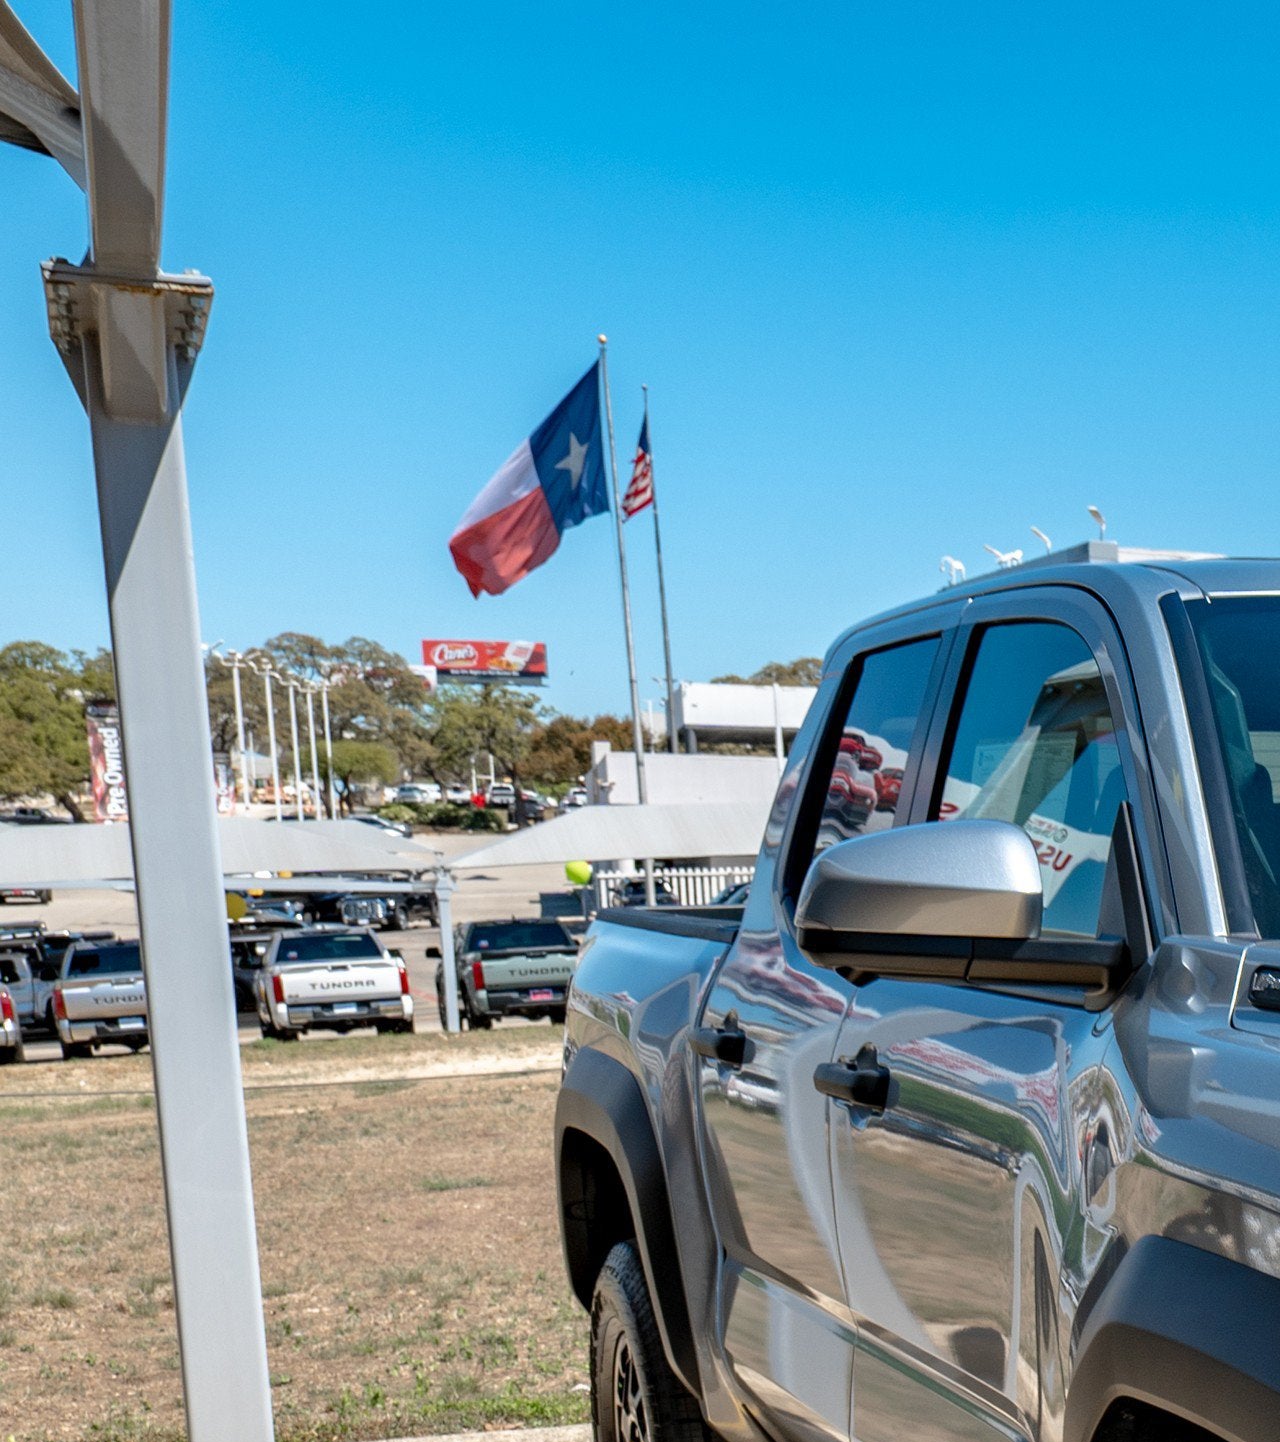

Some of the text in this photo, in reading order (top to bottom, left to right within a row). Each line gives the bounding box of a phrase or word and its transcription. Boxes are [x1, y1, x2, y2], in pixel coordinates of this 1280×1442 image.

[97, 726, 123, 786] Owned
[107, 787, 127, 815] Pre
[509, 967, 571, 977] TUNDRA
[309, 979, 376, 990] TUNDRA
[92, 994, 146, 1005] TUND
